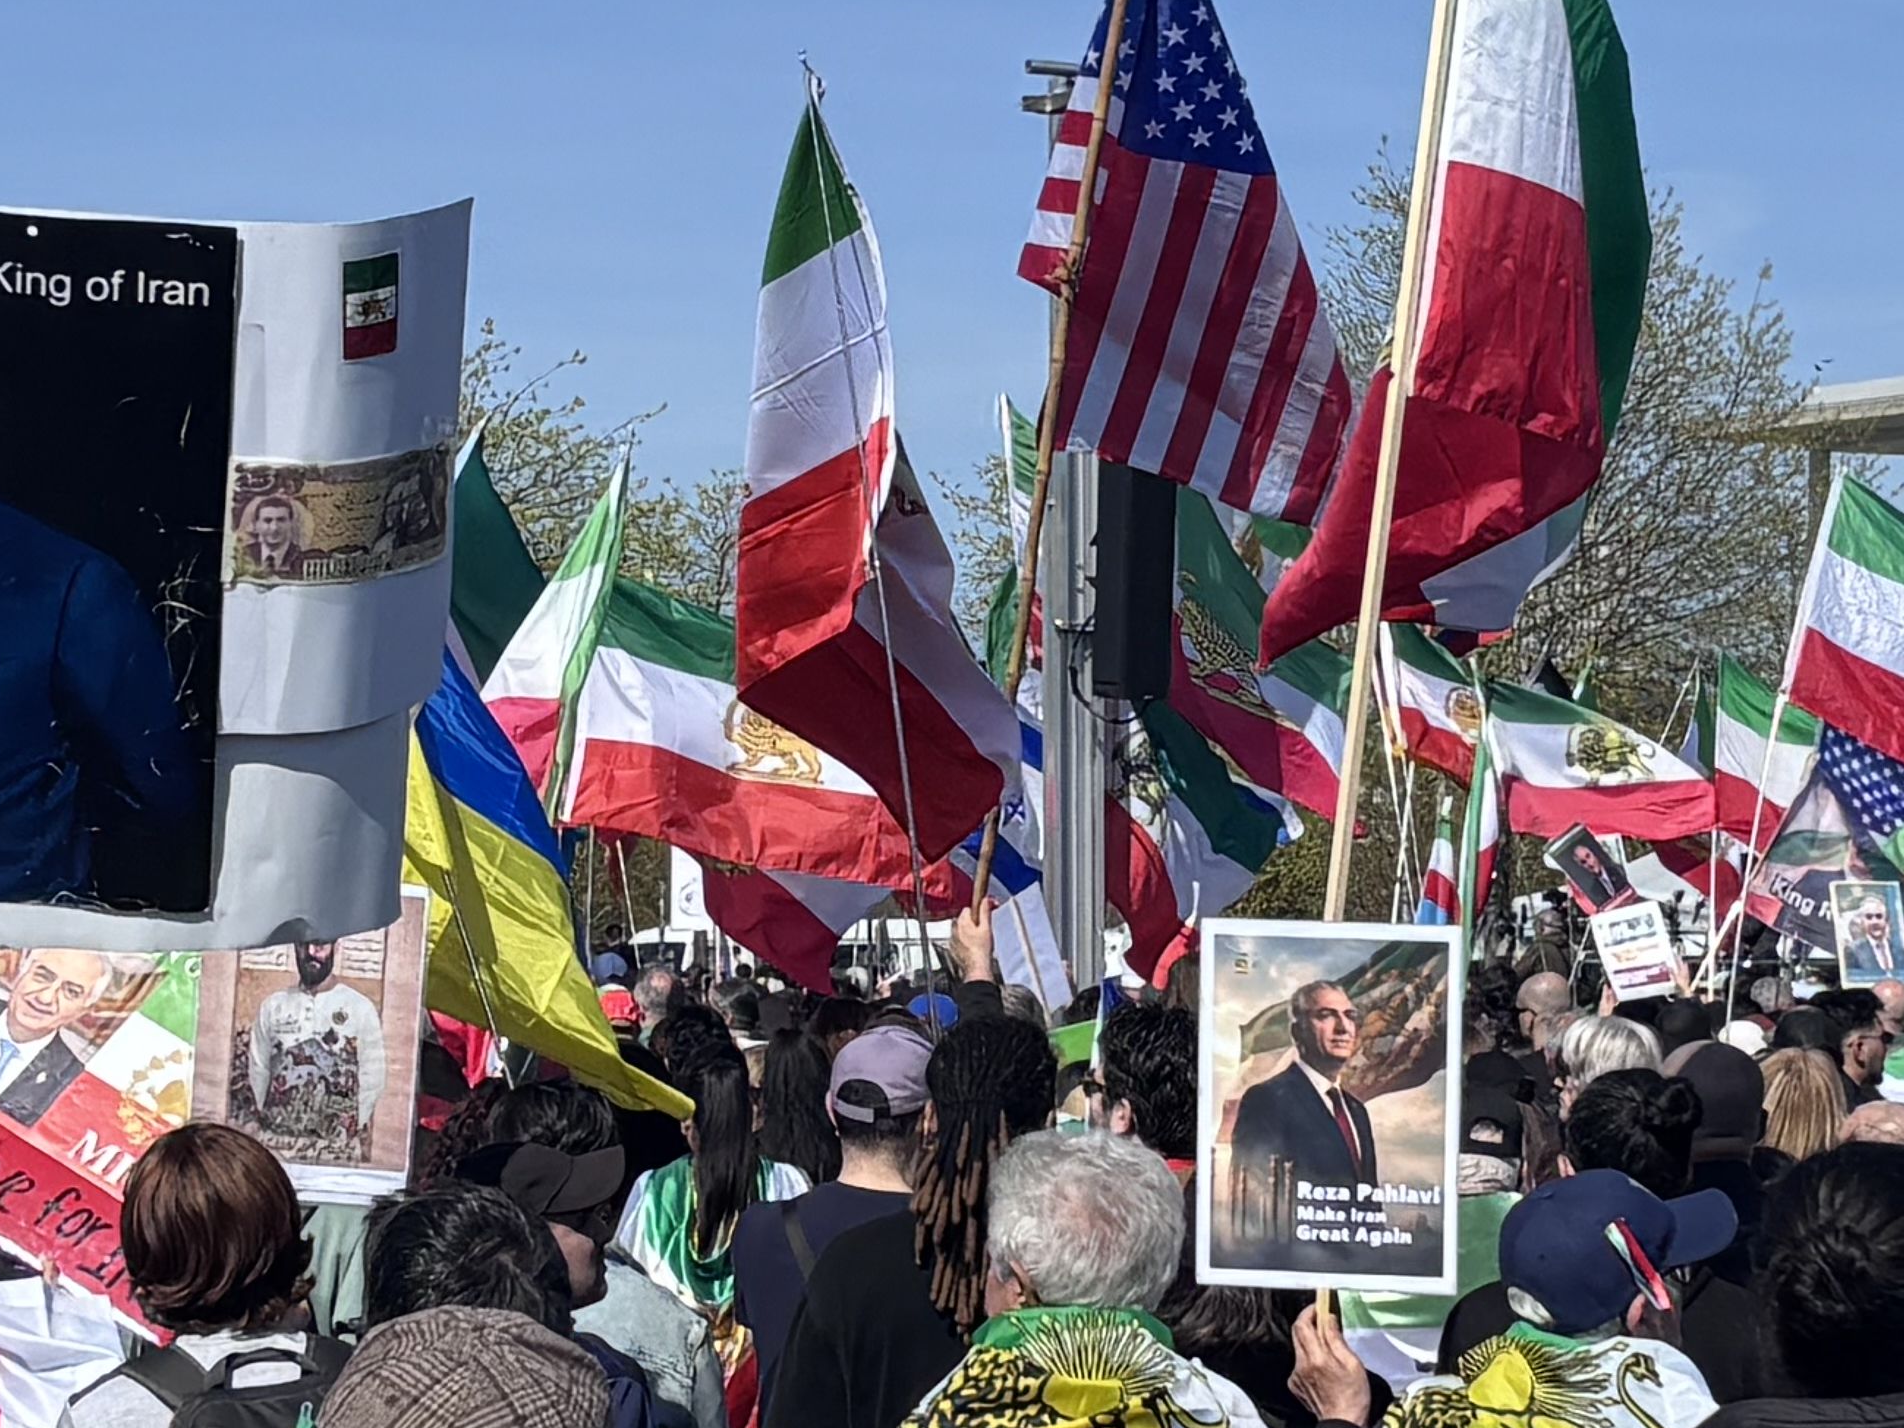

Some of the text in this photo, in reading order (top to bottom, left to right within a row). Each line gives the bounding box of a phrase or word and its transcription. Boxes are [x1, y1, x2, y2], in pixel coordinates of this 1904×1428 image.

[85, 269, 125, 302] of
[136, 270, 211, 307] Iran
[1770, 873, 1816, 916] King
[1296, 1180, 1441, 1204] Reza Pahlavi
[33, 1186, 113, 1249] for
[1296, 1205, 1388, 1224] Make Iran
[1296, 1224, 1413, 1248] Great Again
